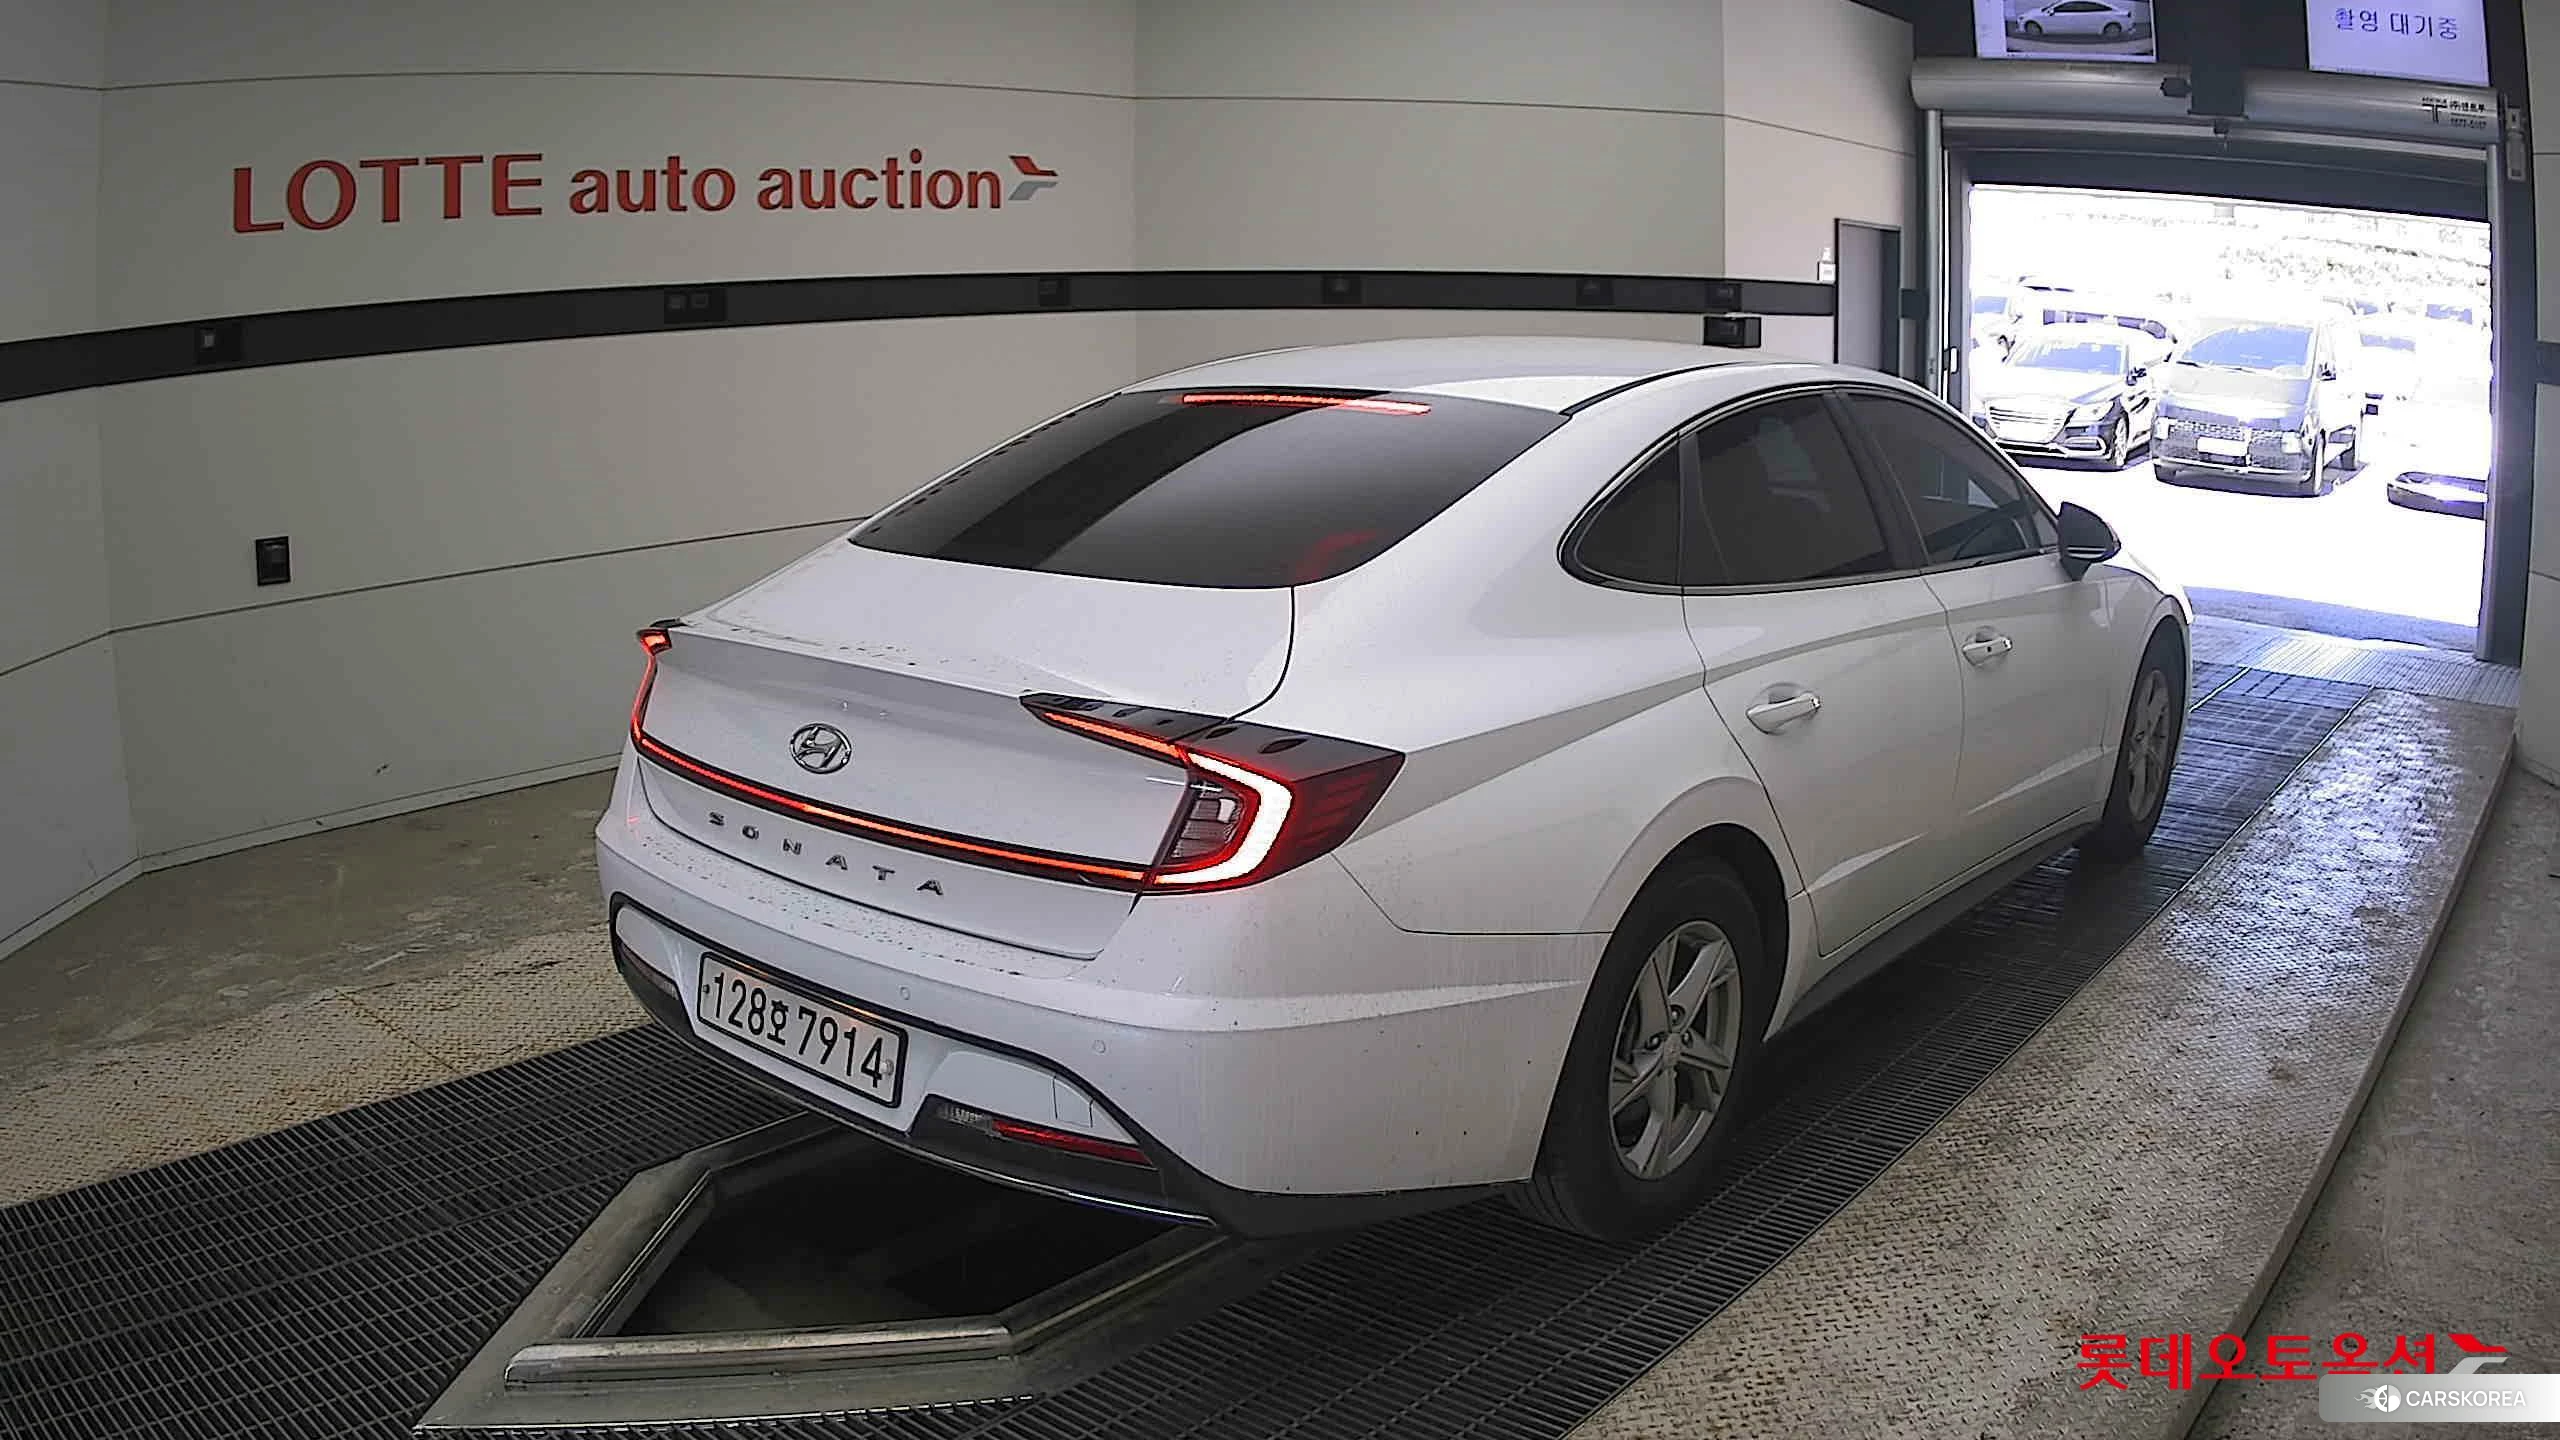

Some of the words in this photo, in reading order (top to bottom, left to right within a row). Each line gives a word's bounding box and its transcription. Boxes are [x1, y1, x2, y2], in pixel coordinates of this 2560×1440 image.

[2390, 12, 2457, 40] 대기중
[233, 153, 543, 234] LOTTE
[568, 155, 737, 215] auto
[756, 147, 1003, 211] auction
[708, 810, 944, 897] SONATA
